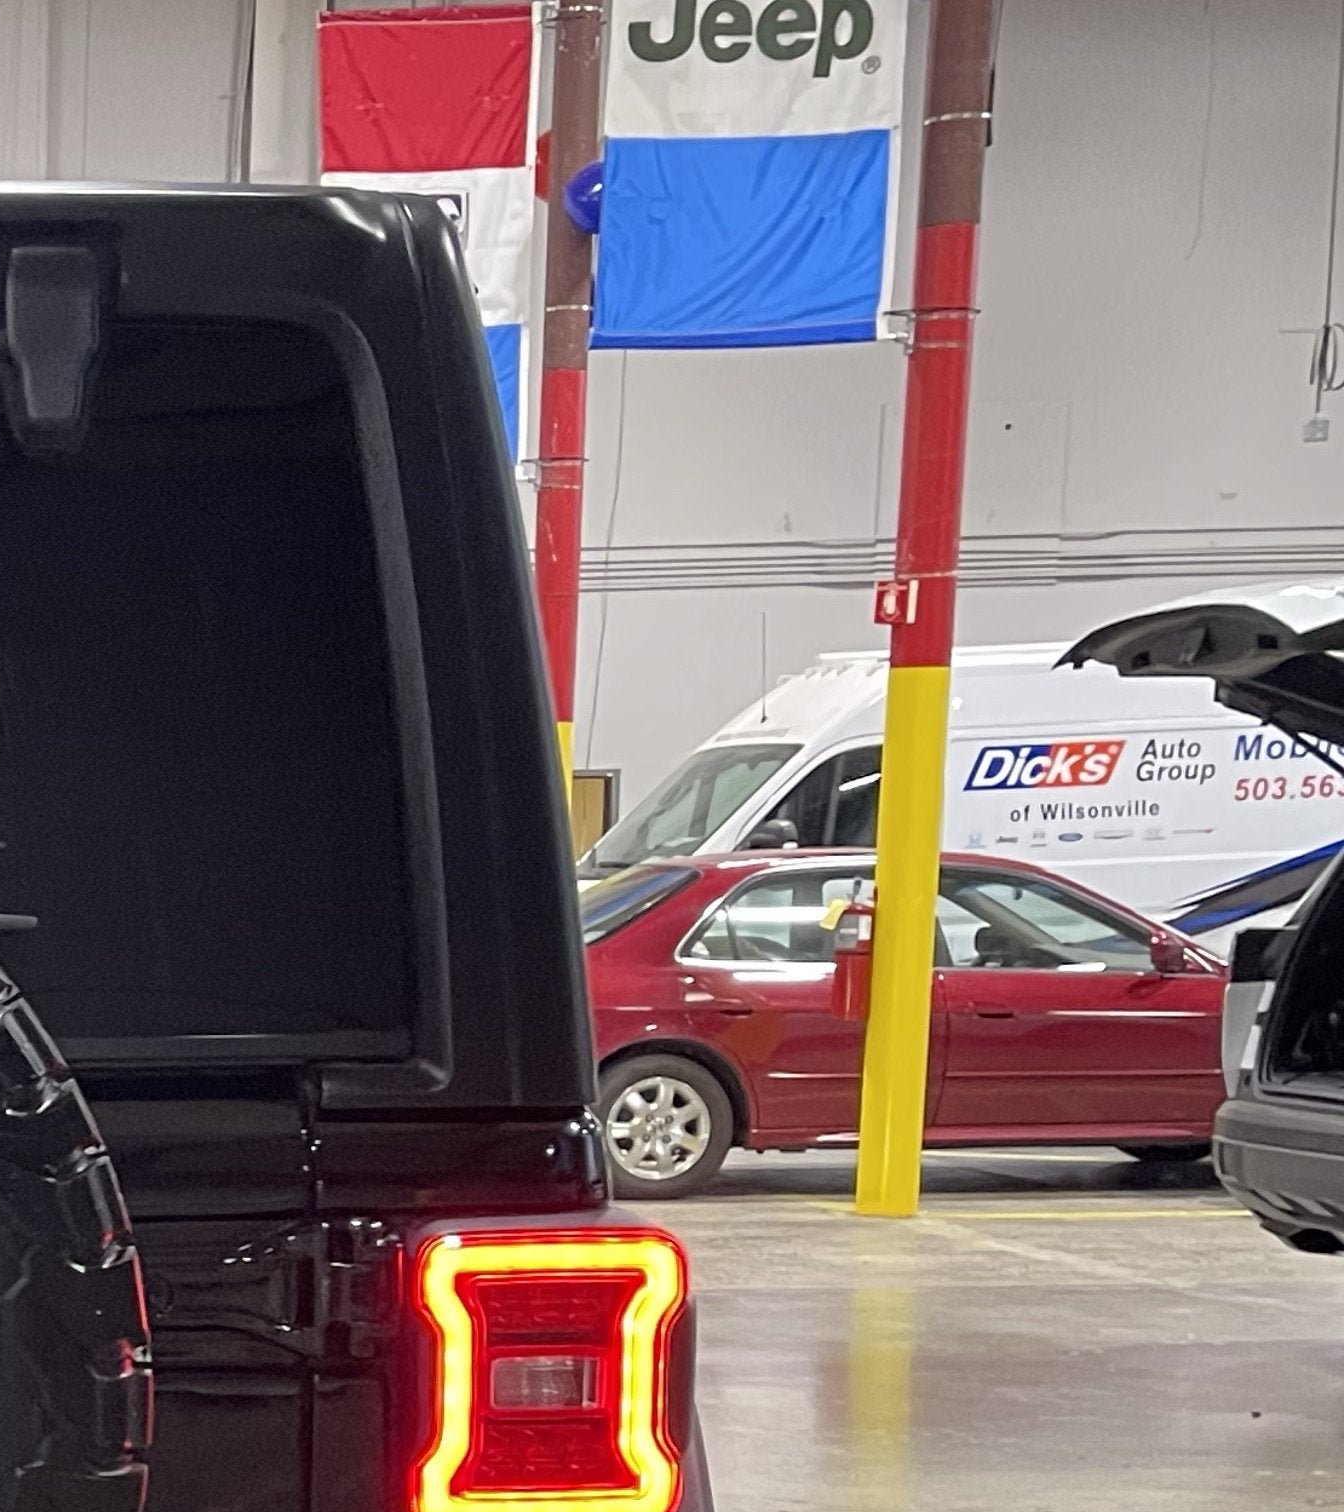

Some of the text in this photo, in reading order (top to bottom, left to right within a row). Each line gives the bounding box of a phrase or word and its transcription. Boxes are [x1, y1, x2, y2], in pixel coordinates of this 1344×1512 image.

[627, 0, 874, 78] Jeep
[1141, 738, 1202, 761] Auto
[969, 742, 1118, 788] Dick's
[1135, 760, 1216, 785] Group
[1010, 800, 1161, 823] of Wilsonville
